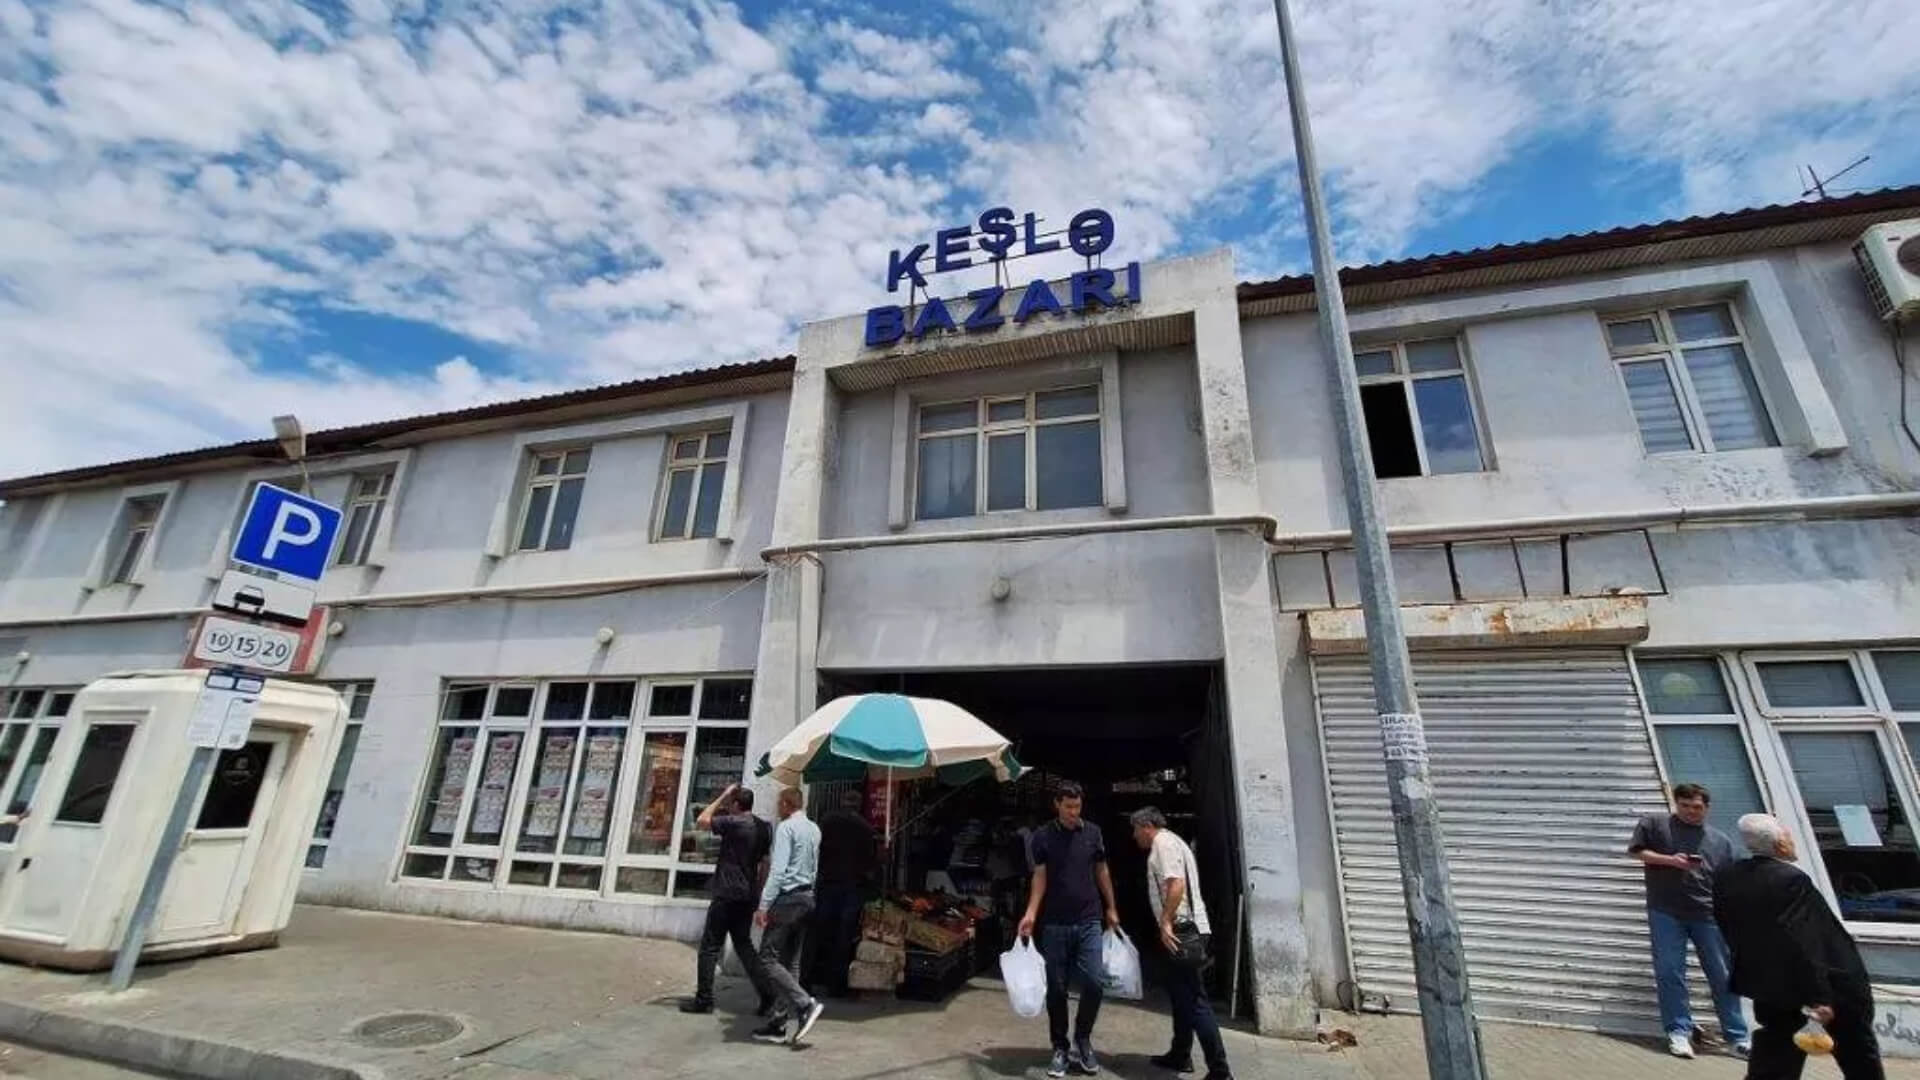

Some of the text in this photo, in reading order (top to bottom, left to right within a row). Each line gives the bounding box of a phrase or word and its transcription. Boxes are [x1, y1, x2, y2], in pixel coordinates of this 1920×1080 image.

[865, 262, 1141, 347] BAZARI
[262, 501, 322, 560] P
[210, 633, 287, 658] 10 15 20
